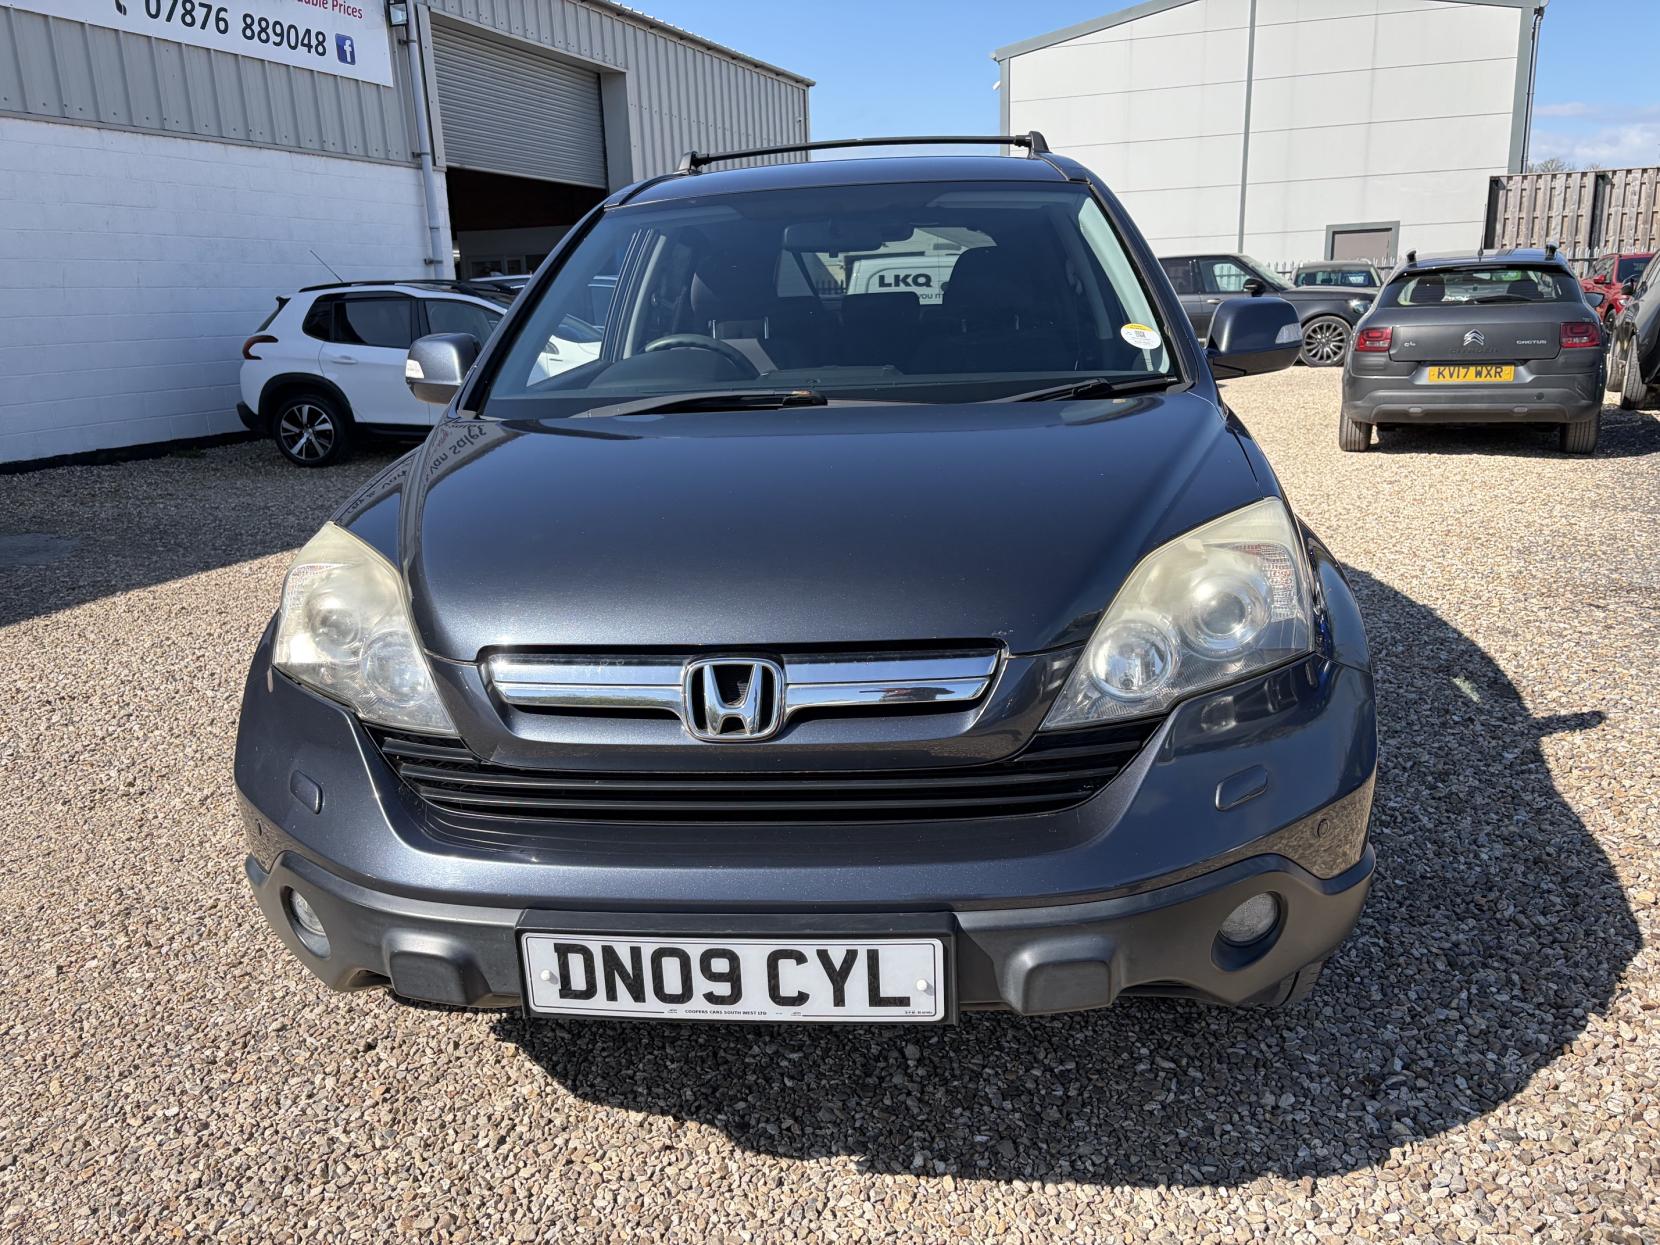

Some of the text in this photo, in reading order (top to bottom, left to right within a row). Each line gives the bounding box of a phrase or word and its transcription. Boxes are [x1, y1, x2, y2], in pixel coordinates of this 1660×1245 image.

[297, 0, 363, 19] able Prices
[144, 0, 327, 57] 07876 889048
[879, 273, 933, 288] LKQ
[1437, 366, 1504, 379] KV17 WXR
[553, 942, 911, 1008] DN09 CYL
